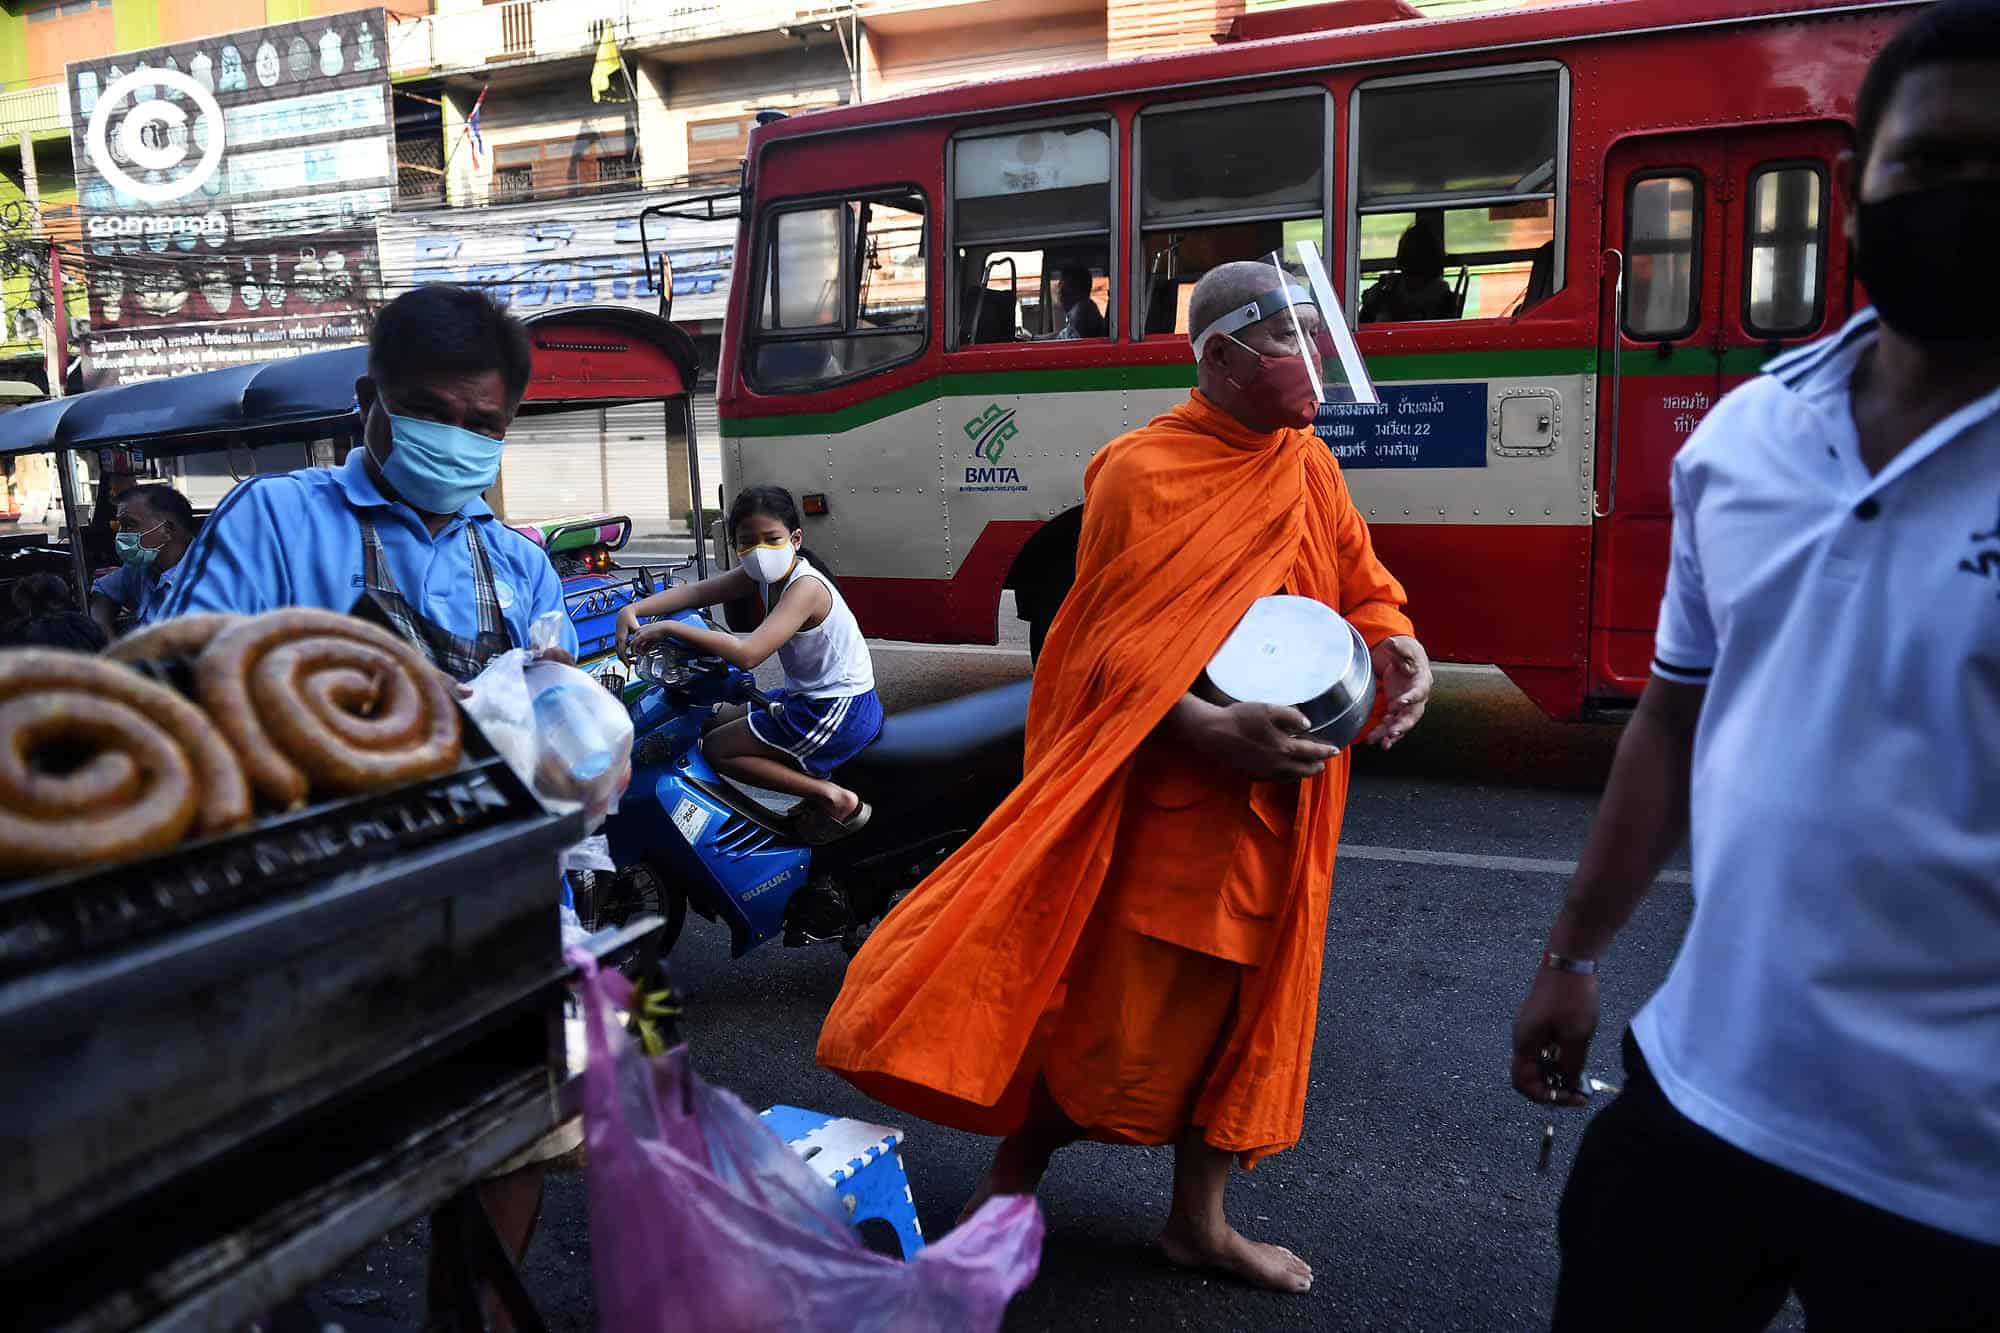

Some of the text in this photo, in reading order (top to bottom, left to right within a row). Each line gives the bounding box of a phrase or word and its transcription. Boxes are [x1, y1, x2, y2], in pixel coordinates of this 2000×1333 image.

[1663, 392, 1709, 409] ขออภัย
[1375, 420, 1411, 437] วงเวียน
[1414, 423, 1431, 436] 22
[1374, 441, 1419, 462] บางลำพู
[965, 467, 1020, 483] BMTA
[683, 803, 699, 824] 2562
[741, 869, 792, 902] SUZUKI
